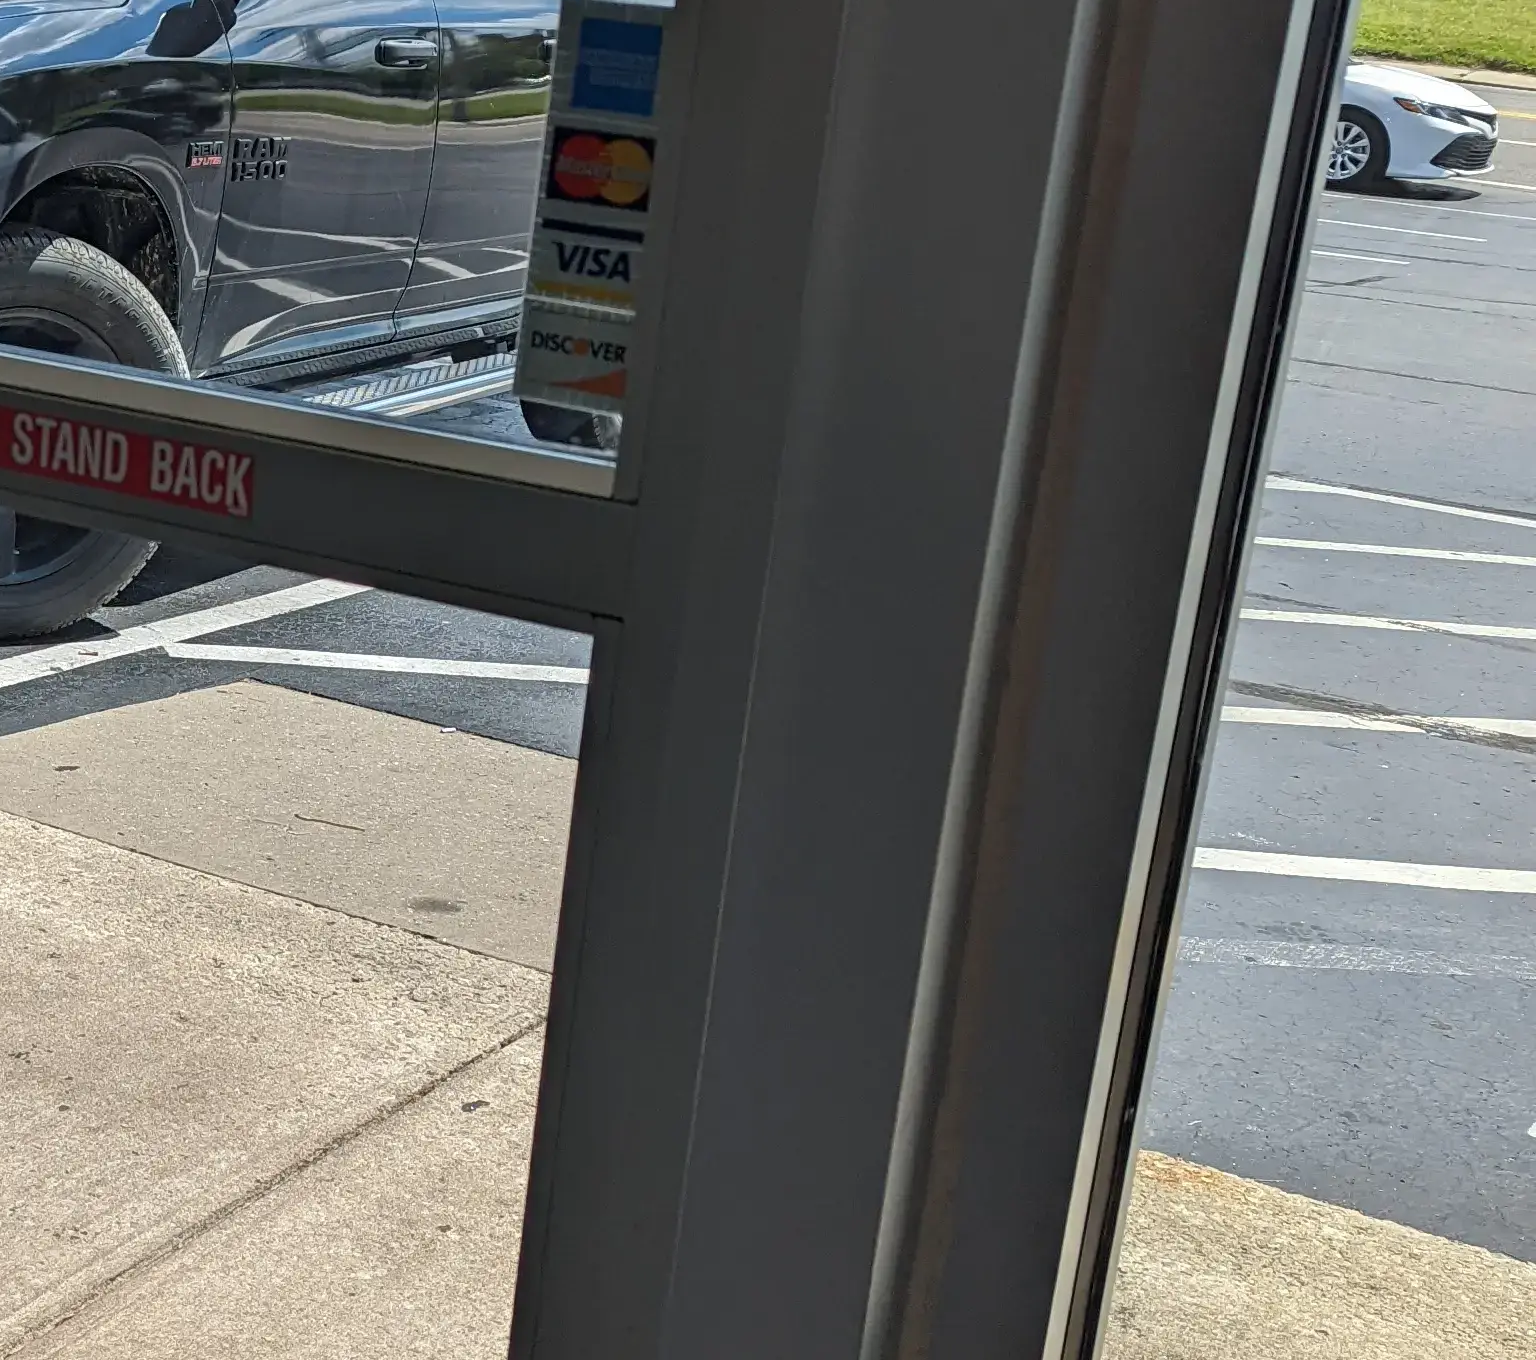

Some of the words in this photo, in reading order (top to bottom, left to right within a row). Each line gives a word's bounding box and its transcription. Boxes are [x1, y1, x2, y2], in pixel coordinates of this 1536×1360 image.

[233, 137, 292, 159] RAM
[231, 160, 288, 181] 1500
[552, 241, 631, 283] VISA
[531, 330, 628, 364] DISCOVER
[11, 411, 130, 485] STAND
[150, 440, 253, 510] BACK
